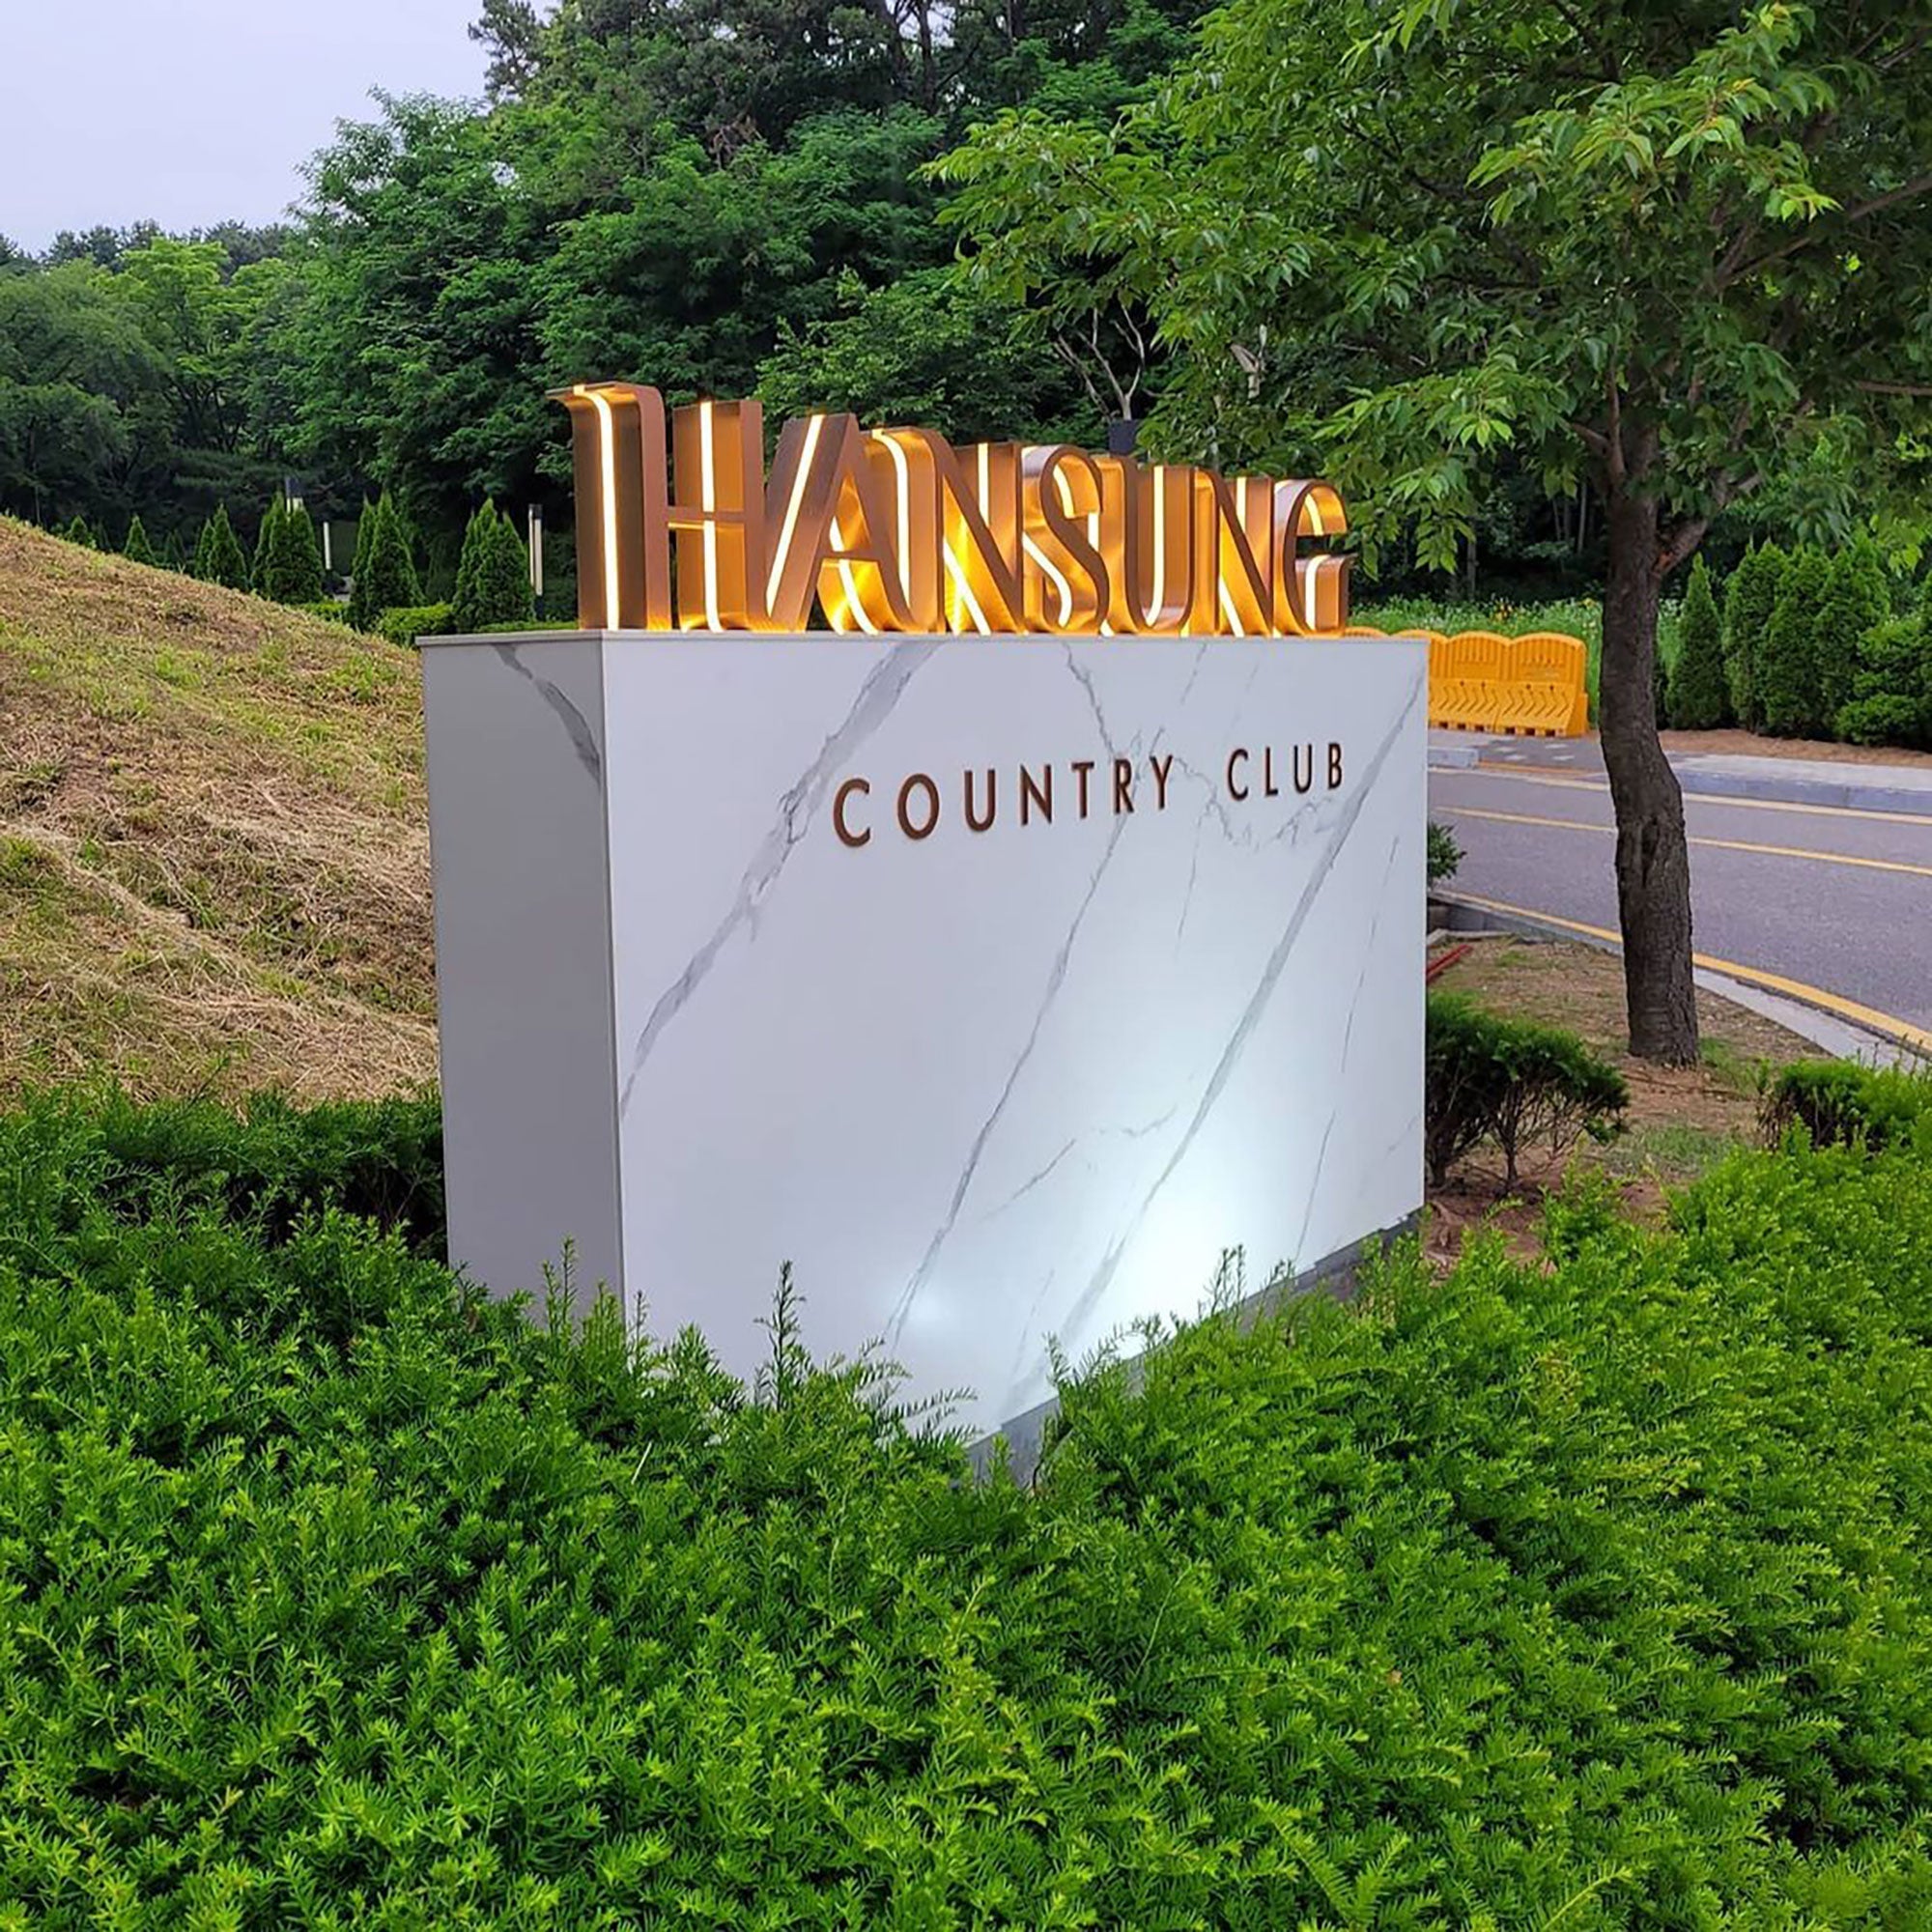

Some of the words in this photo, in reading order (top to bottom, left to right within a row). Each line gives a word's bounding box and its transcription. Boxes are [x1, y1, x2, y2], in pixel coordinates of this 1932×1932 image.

[548, 384, 1350, 636] HANSUNG
[833, 754, 1175, 847] COUNTRY
[1229, 743, 1343, 802] CLUB
